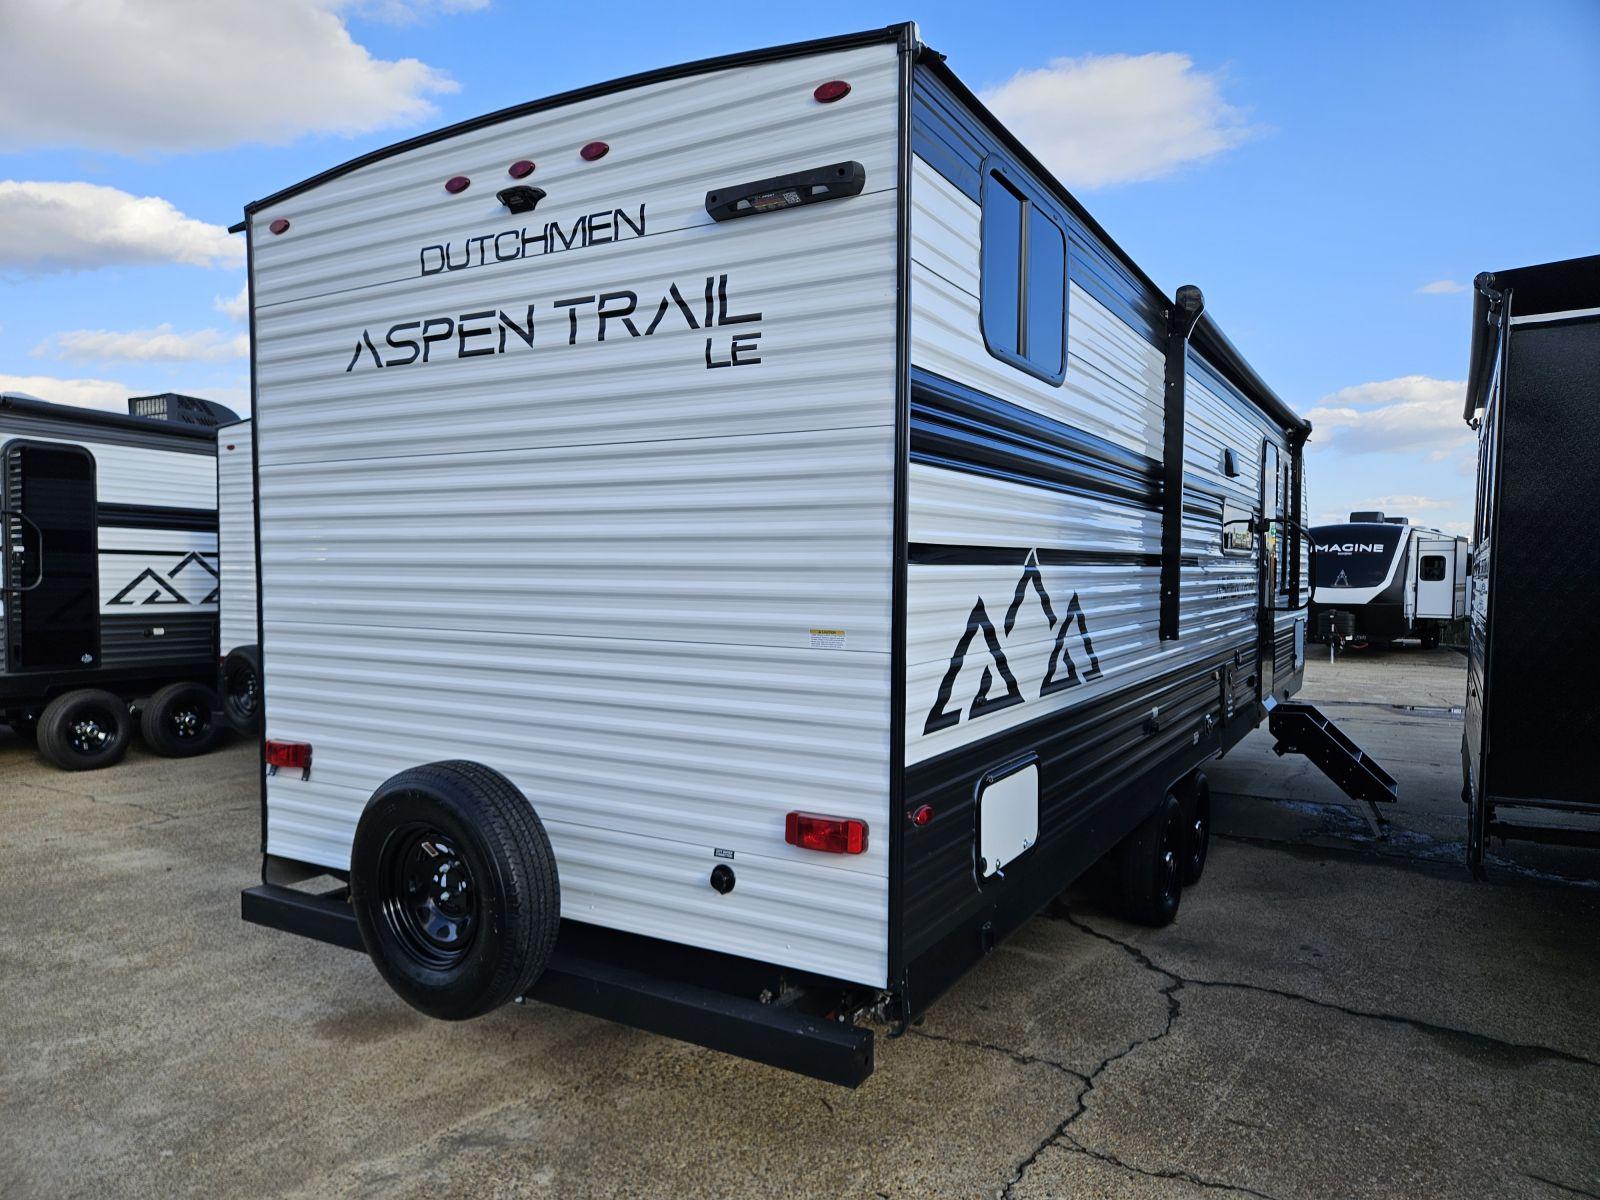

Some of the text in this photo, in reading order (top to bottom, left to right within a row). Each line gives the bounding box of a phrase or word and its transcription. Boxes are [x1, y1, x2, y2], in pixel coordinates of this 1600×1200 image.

[420, 203, 646, 277] DUTCHMEN
[346, 274, 763, 373] ASPEN TRAIL
[705, 331, 762, 370] LE
